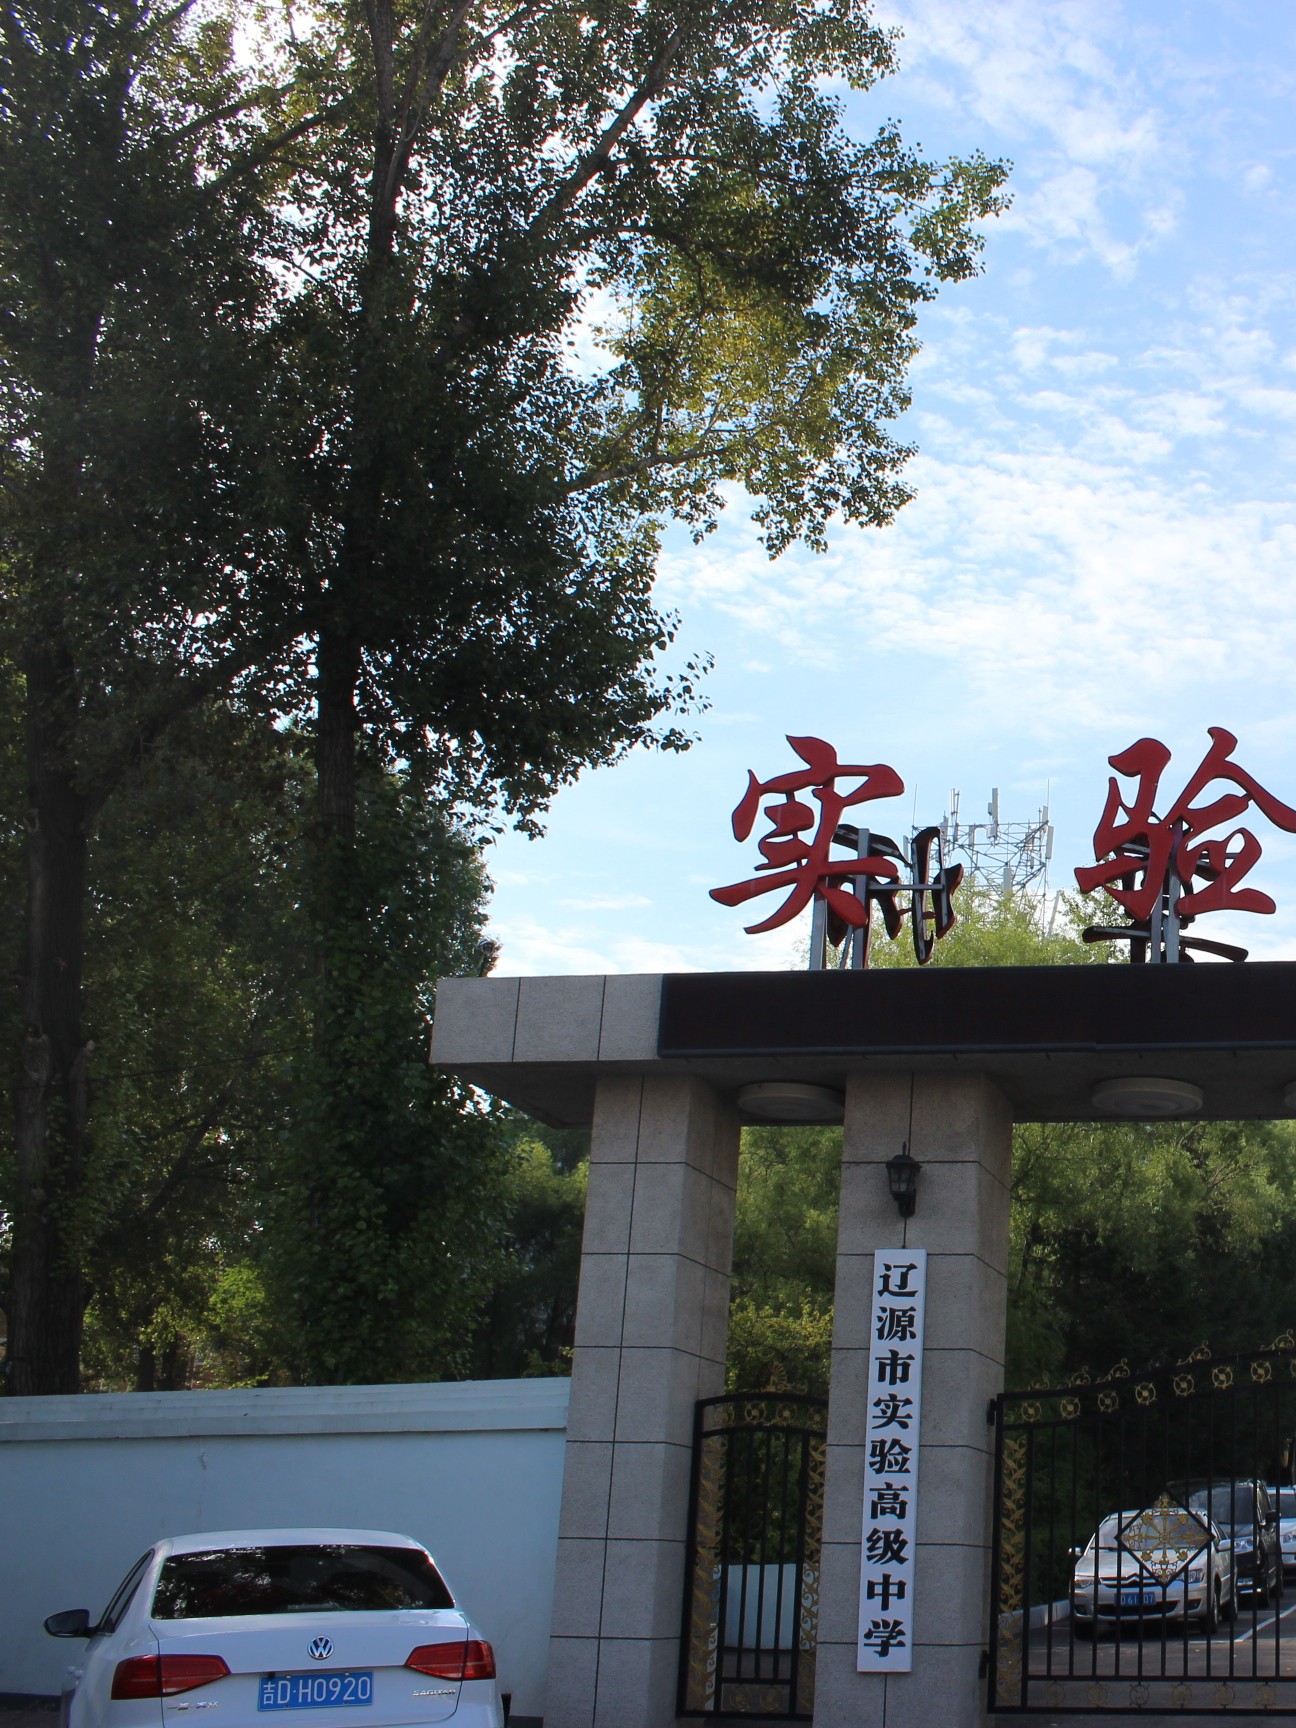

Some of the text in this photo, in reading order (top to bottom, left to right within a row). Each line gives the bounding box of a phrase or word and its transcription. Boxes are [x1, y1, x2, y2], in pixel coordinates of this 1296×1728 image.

[863, 1262, 919, 1658] 辽源市实验高级中学
